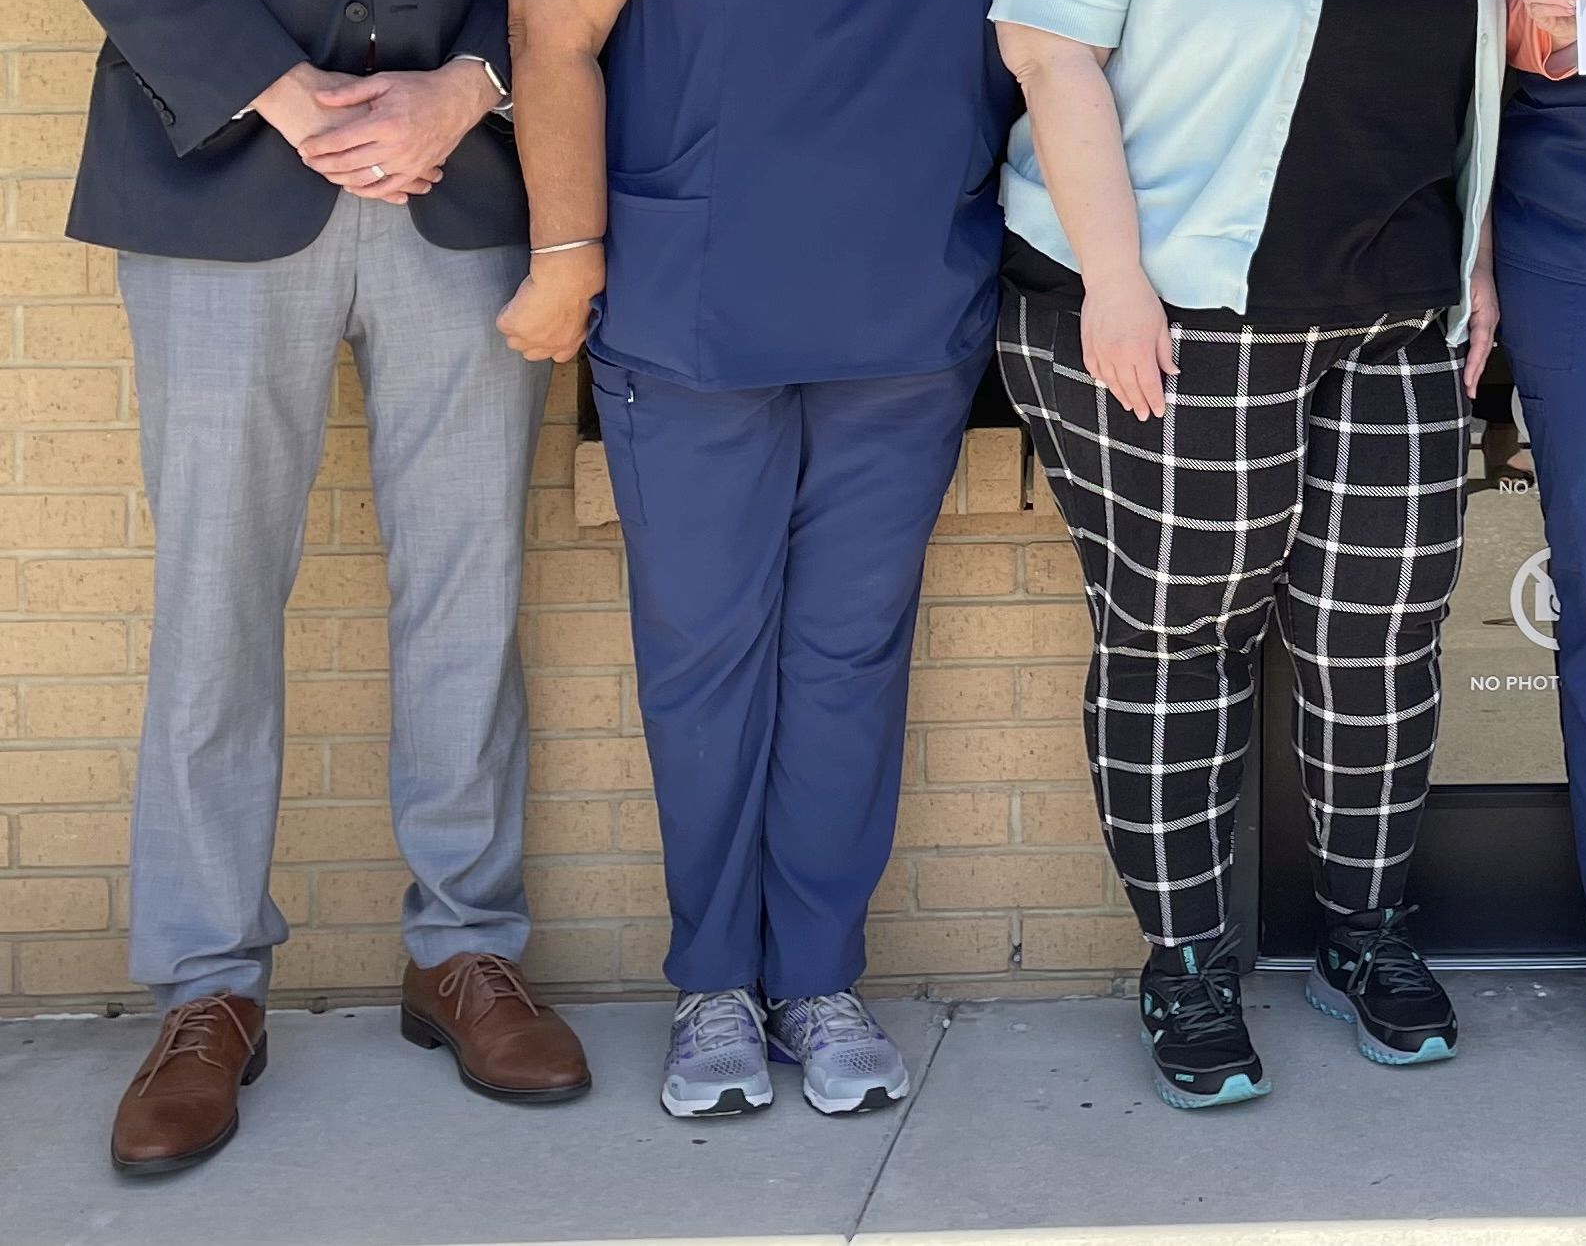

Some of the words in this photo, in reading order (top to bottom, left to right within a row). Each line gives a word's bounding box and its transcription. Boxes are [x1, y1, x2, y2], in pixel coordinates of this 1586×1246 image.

[1499, 481, 1530, 496] NO
[1470, 675, 1501, 692] NO
[1505, 674, 1560, 691] PHOT
